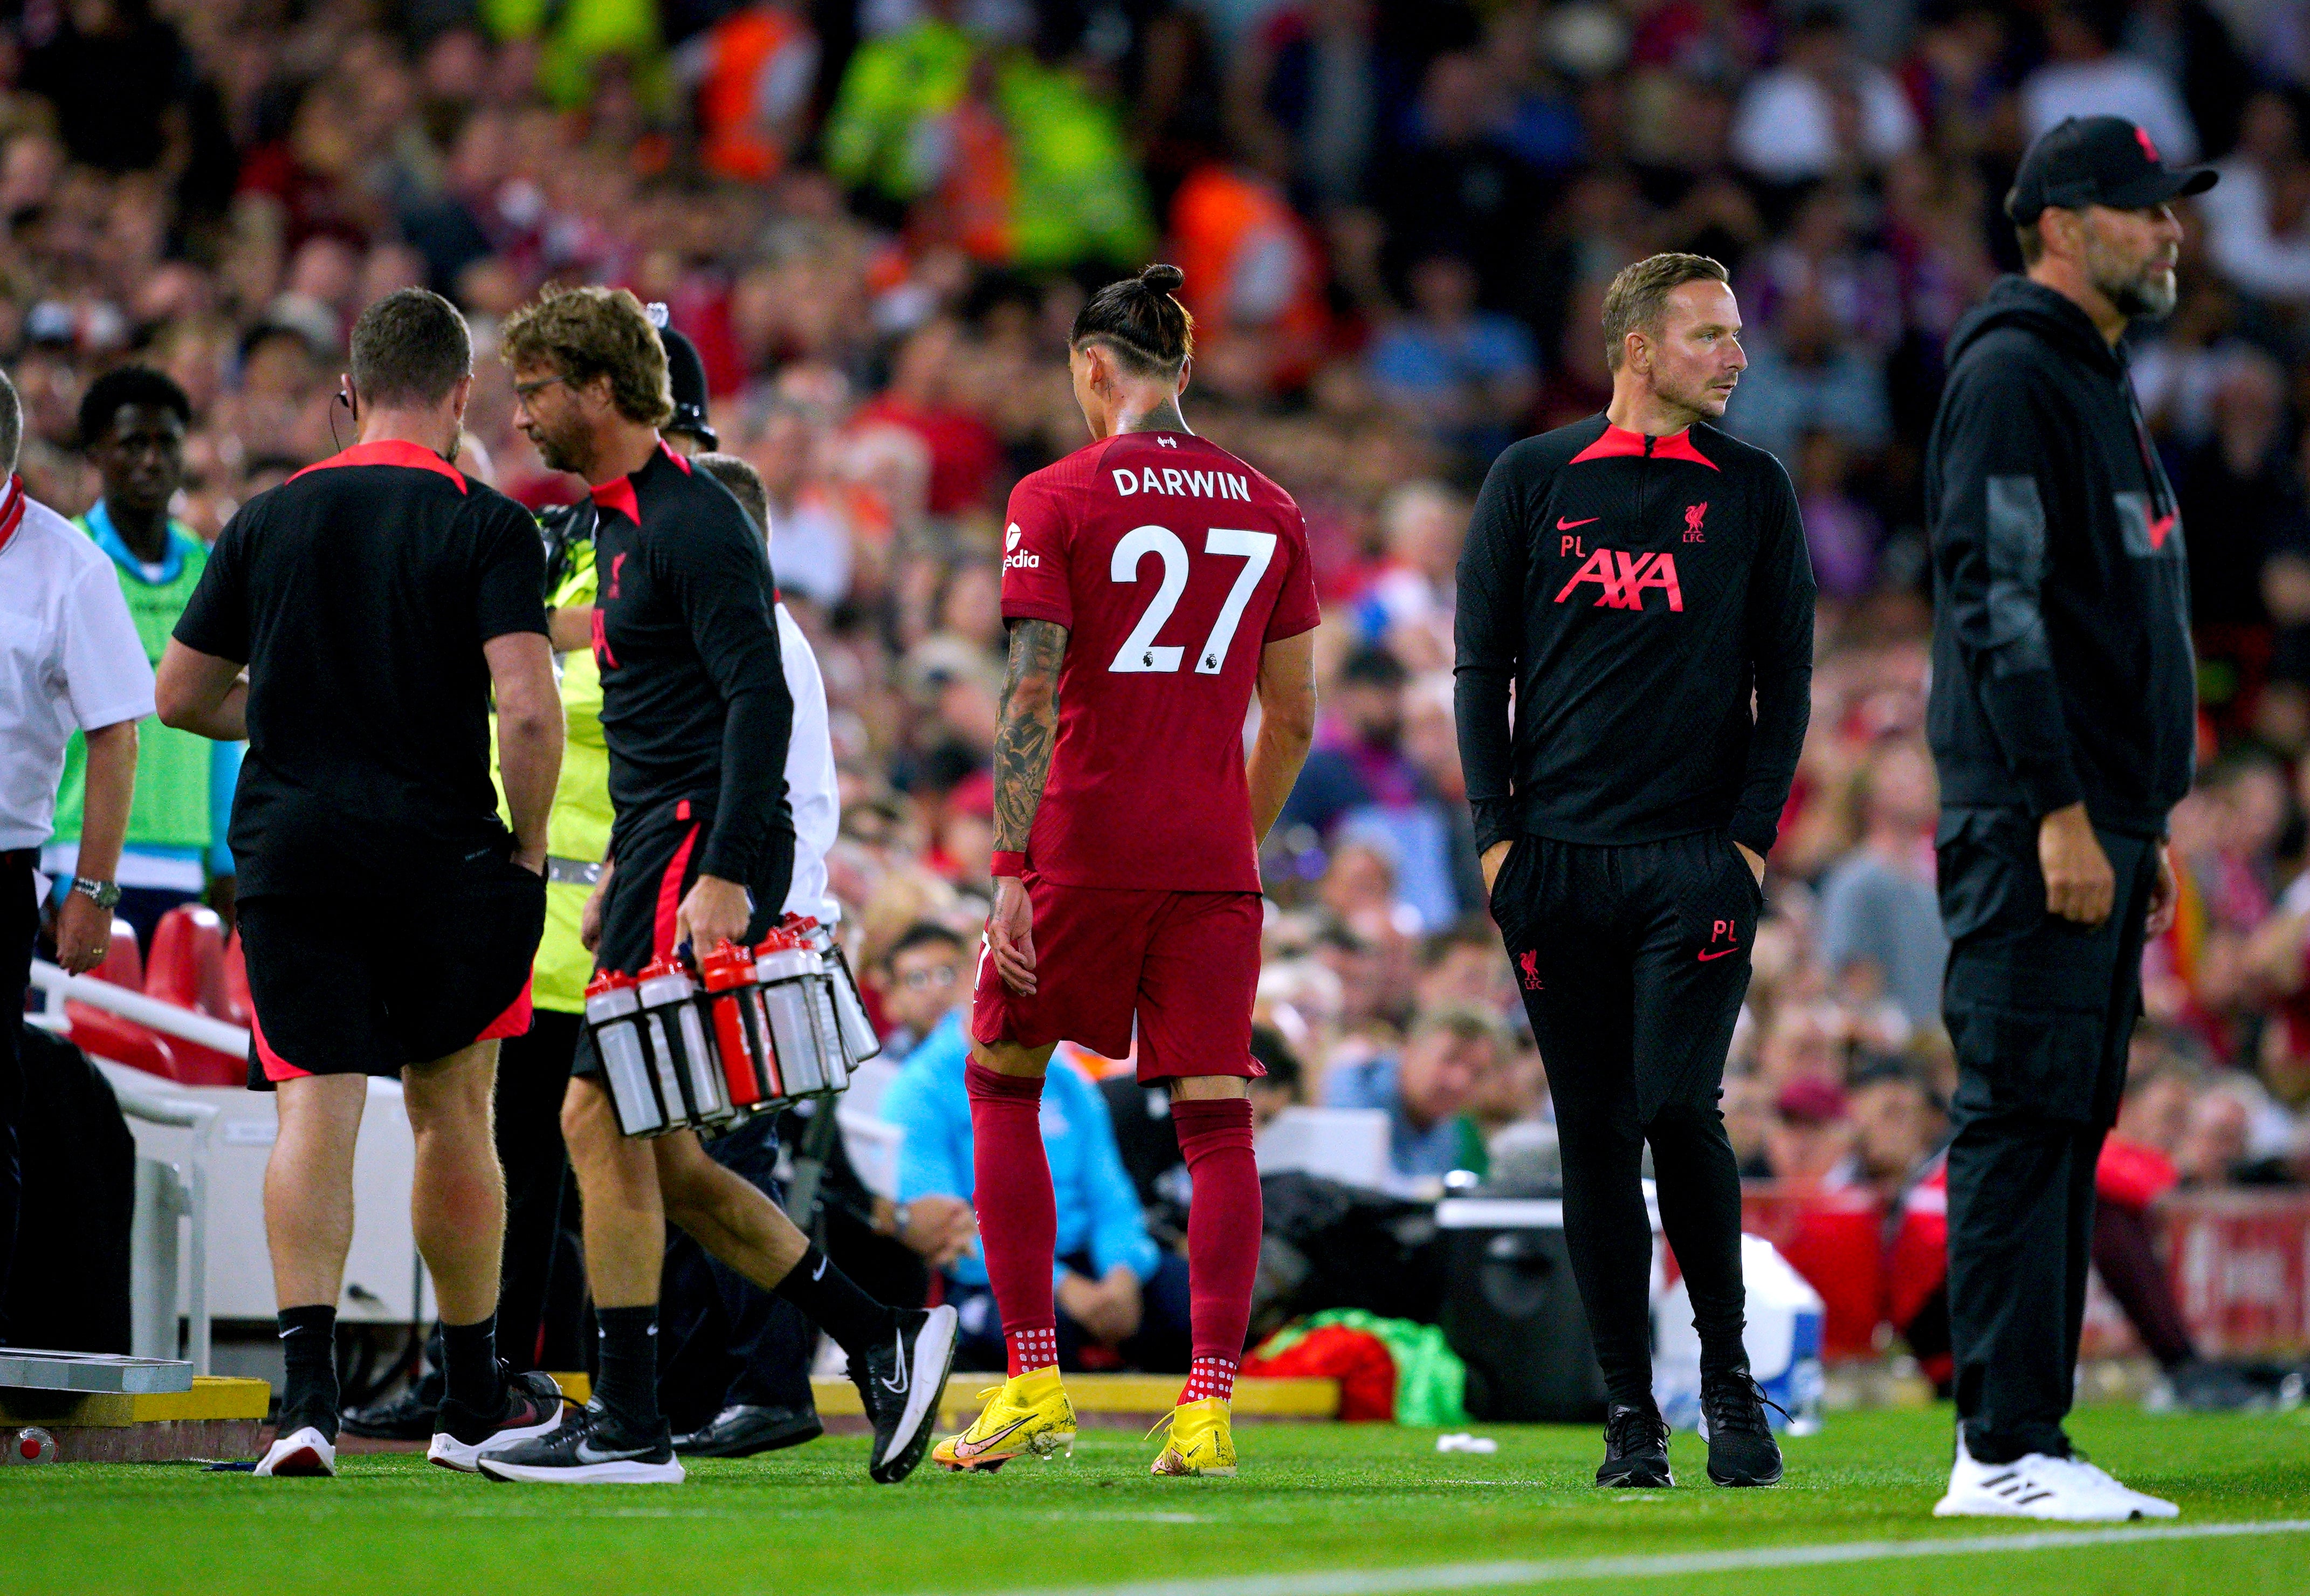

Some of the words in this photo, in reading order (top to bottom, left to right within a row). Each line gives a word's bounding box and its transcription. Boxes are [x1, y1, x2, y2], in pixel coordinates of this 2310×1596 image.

[1111, 467, 1252, 502] DARWIN
[1560, 535, 1586, 558] PL
[1553, 548, 1683, 612] AXA
[1108, 525, 1277, 675] 27
[1711, 920, 1737, 943] PL
